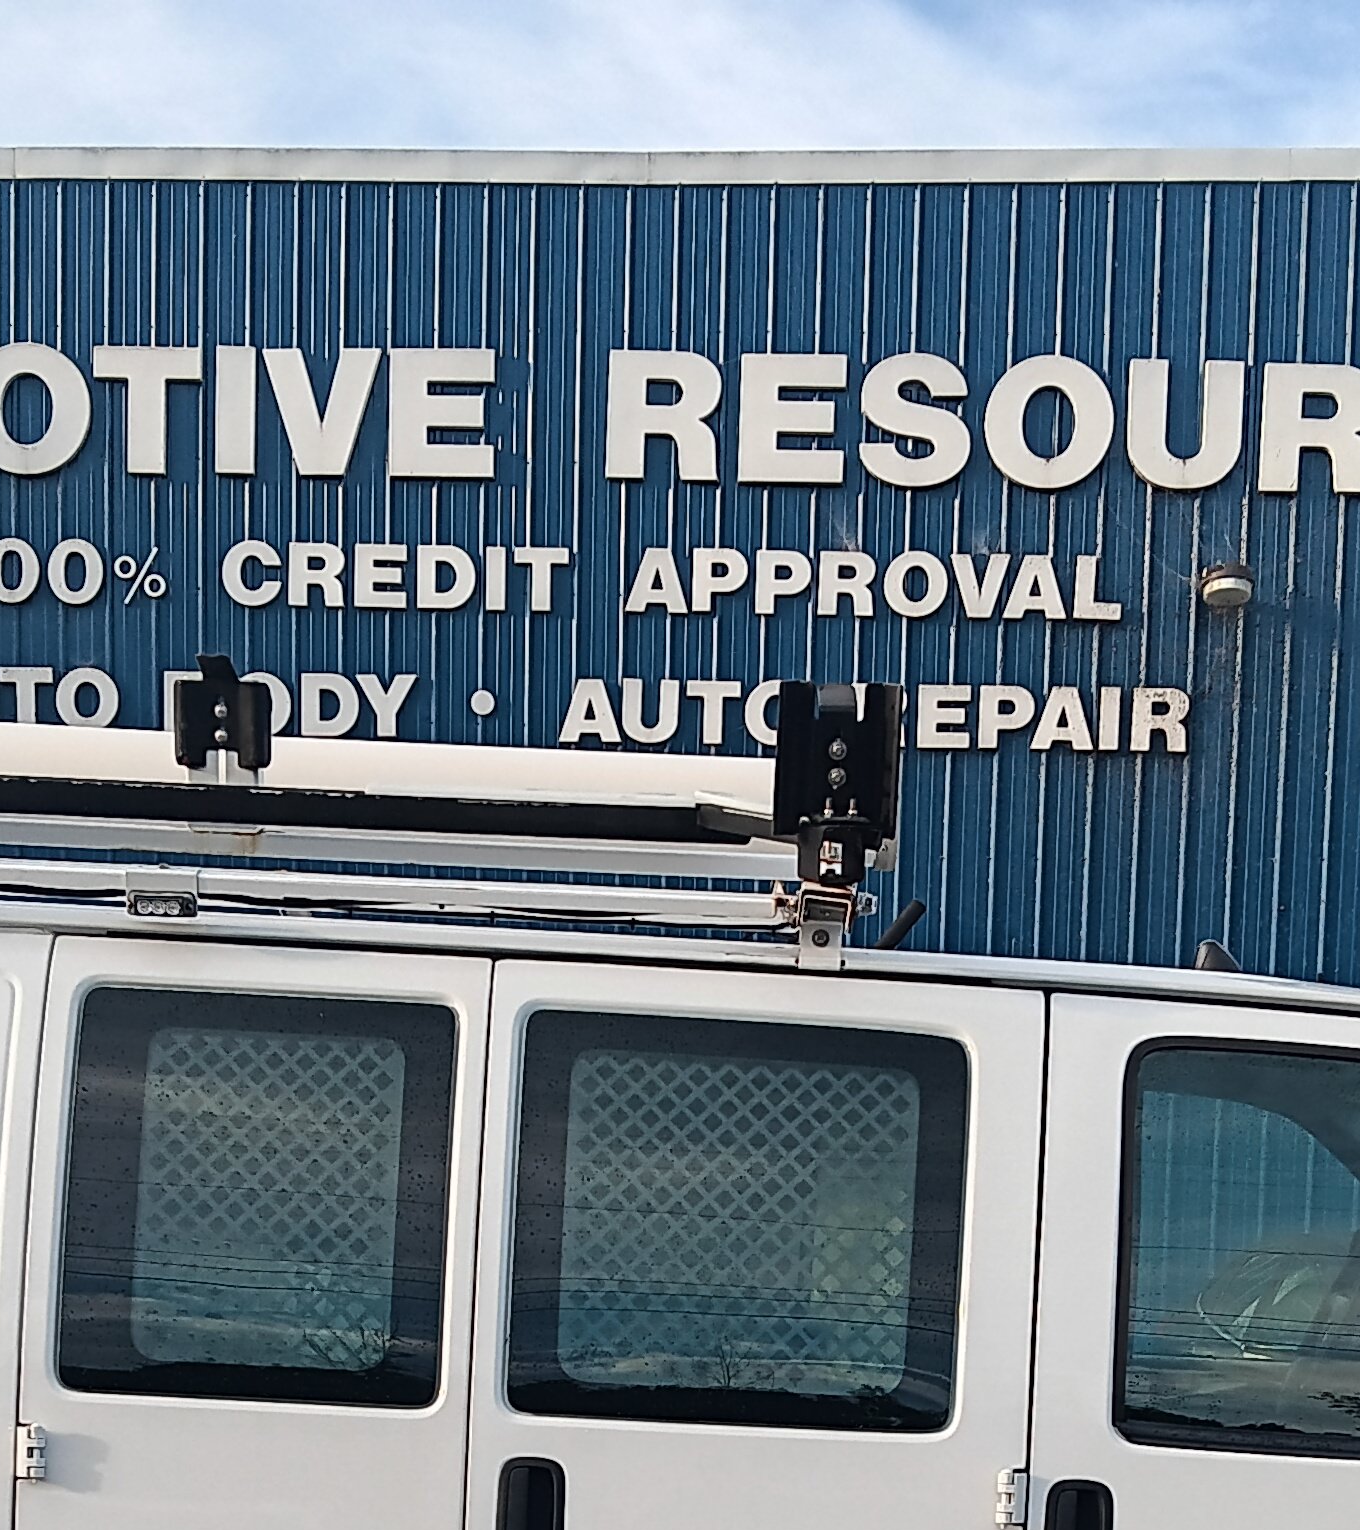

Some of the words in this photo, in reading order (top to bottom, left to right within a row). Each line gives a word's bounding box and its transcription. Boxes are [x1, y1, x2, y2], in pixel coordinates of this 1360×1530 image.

[221, 539, 571, 612] CREDIT
[624, 547, 1123, 622] APPROVAL
[163, 670, 418, 737] DY
[851, 682, 1190, 753] EPAIR
